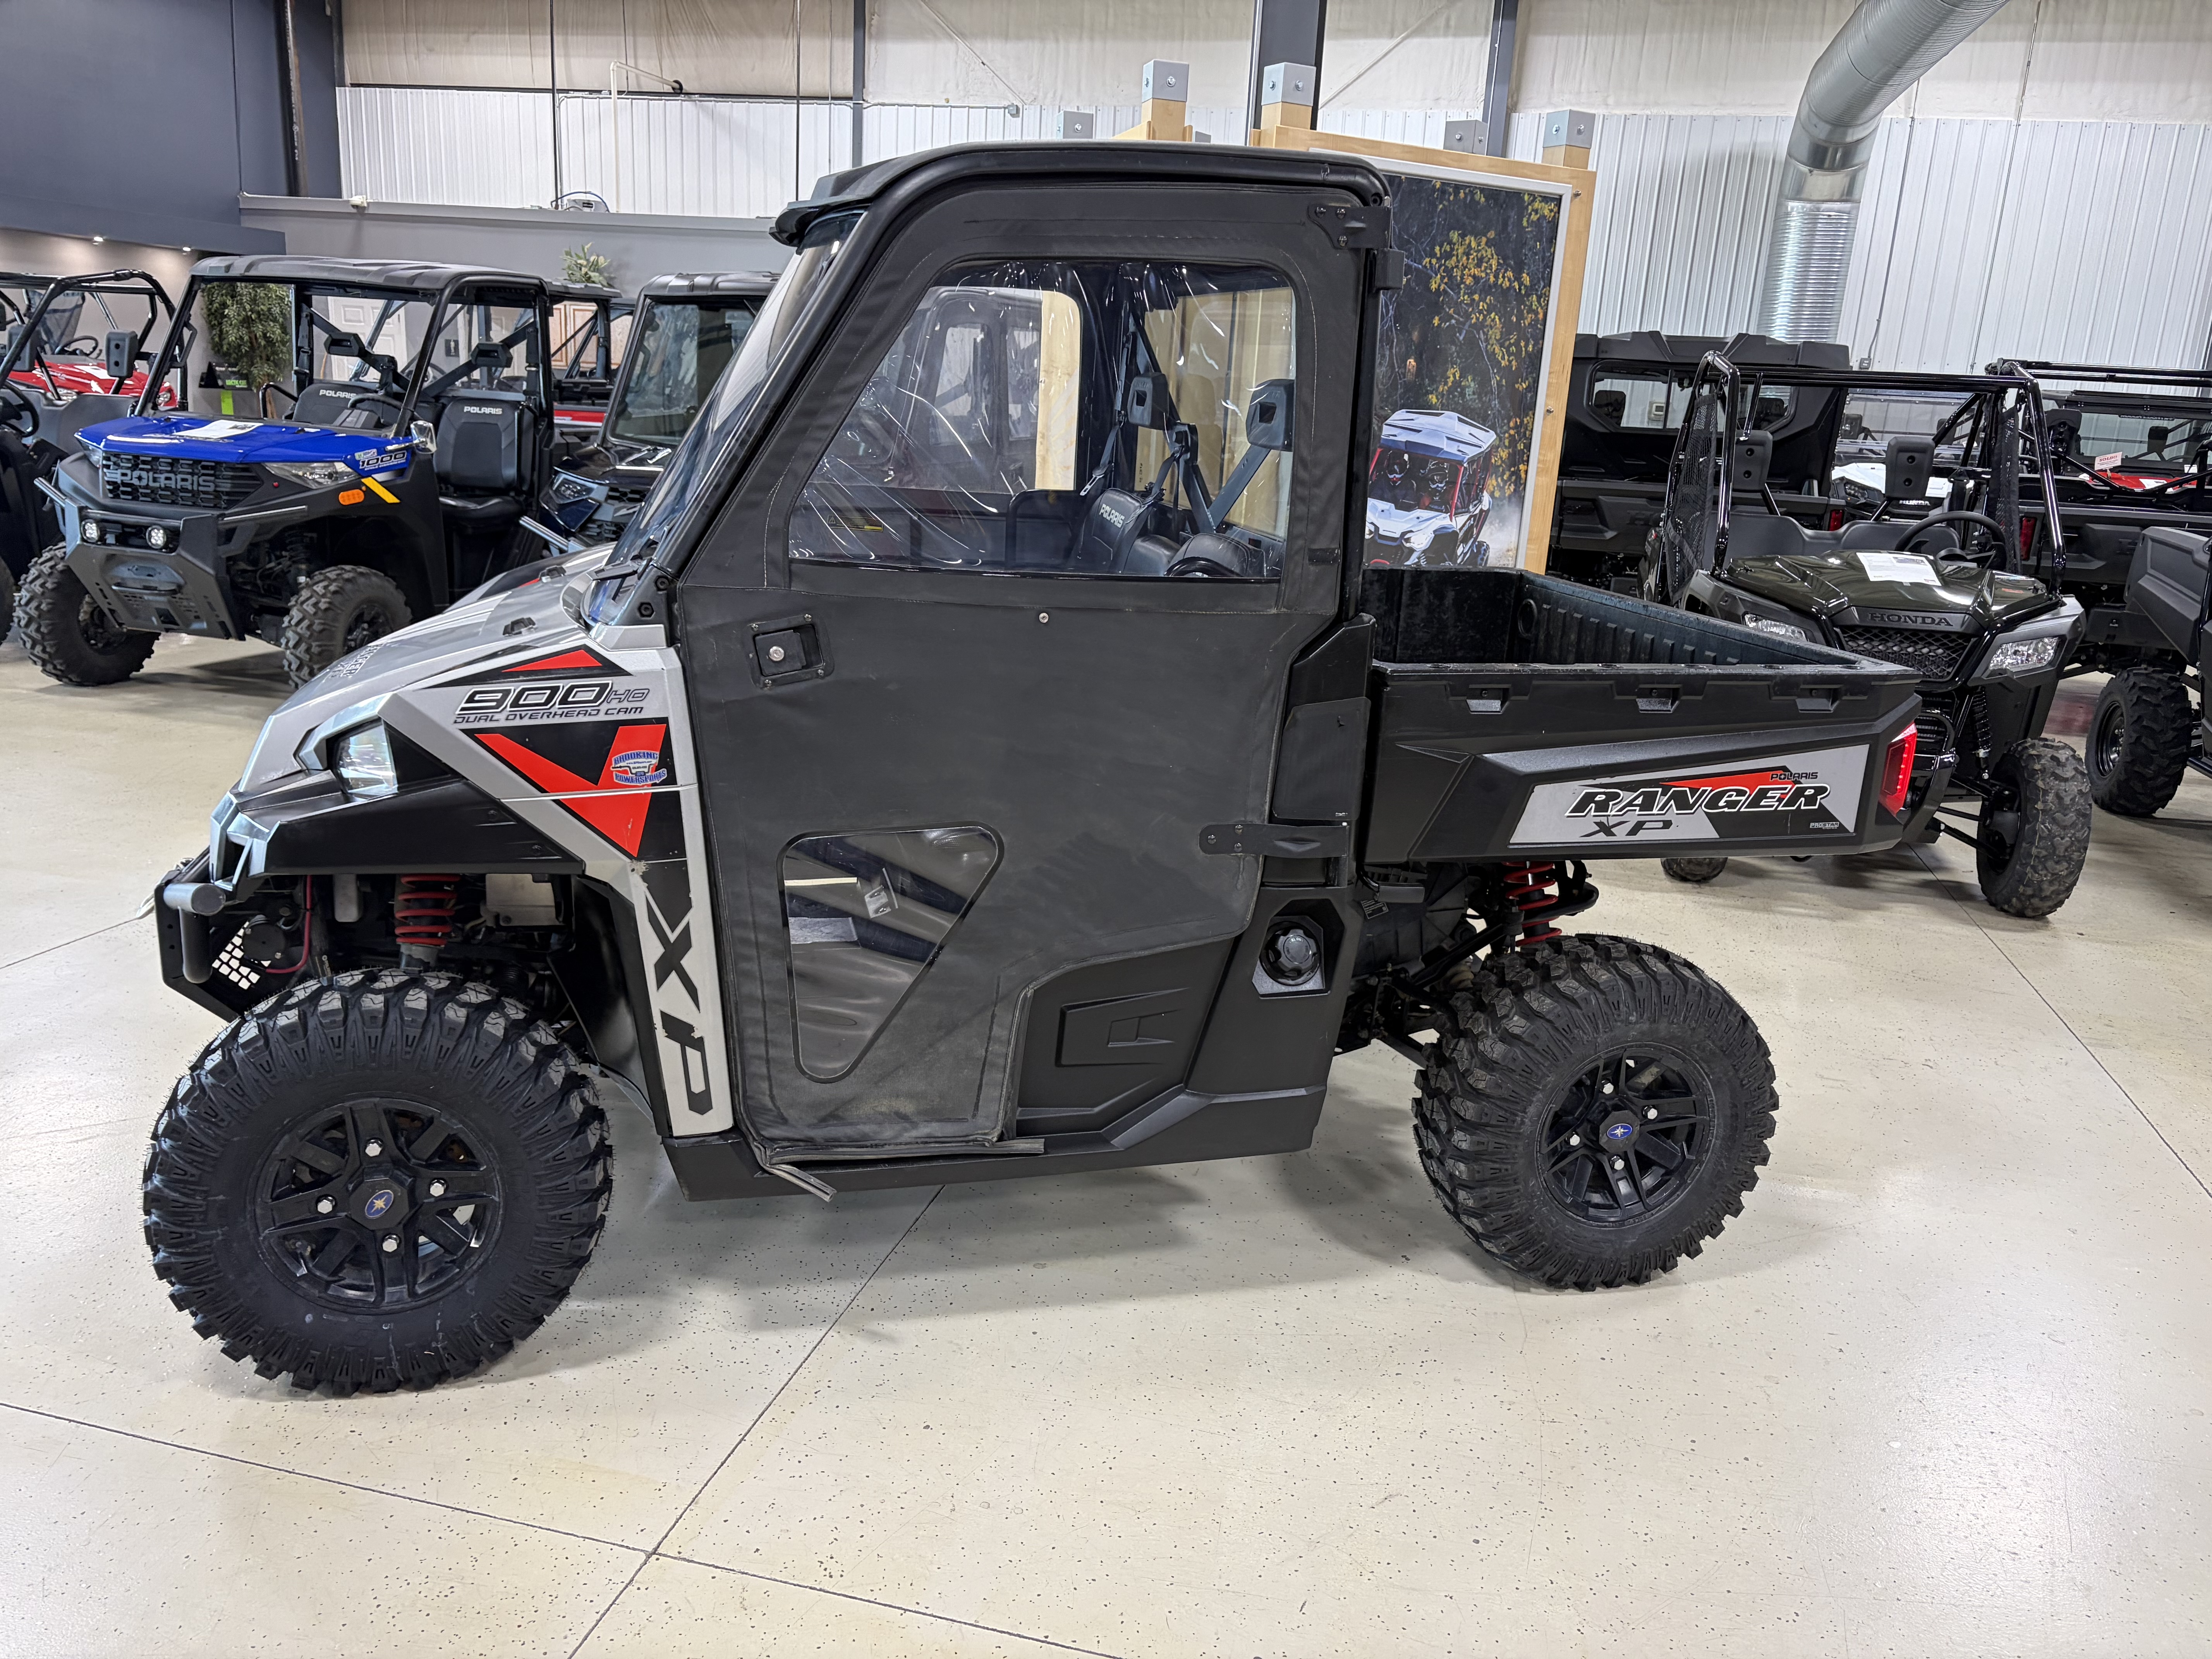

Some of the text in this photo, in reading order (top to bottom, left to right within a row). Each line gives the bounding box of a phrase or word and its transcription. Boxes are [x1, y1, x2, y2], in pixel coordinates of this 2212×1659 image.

[319, 389, 357, 399] POLARIS
[464, 406, 502, 414] POLARIS
[359, 450, 407, 469] 1000
[117, 469, 215, 491] POLARIS
[1099, 503, 1125, 528] POLARIS
[1869, 613, 1954, 627] HONDA
[455, 680, 650, 715] 900 HO
[453, 706, 644, 724] DUAL OVERHEAD CAM
[1770, 772, 1818, 781] POLARIS
[1565, 783, 1831, 818] RANGER
[1579, 820, 1673, 838] XP
